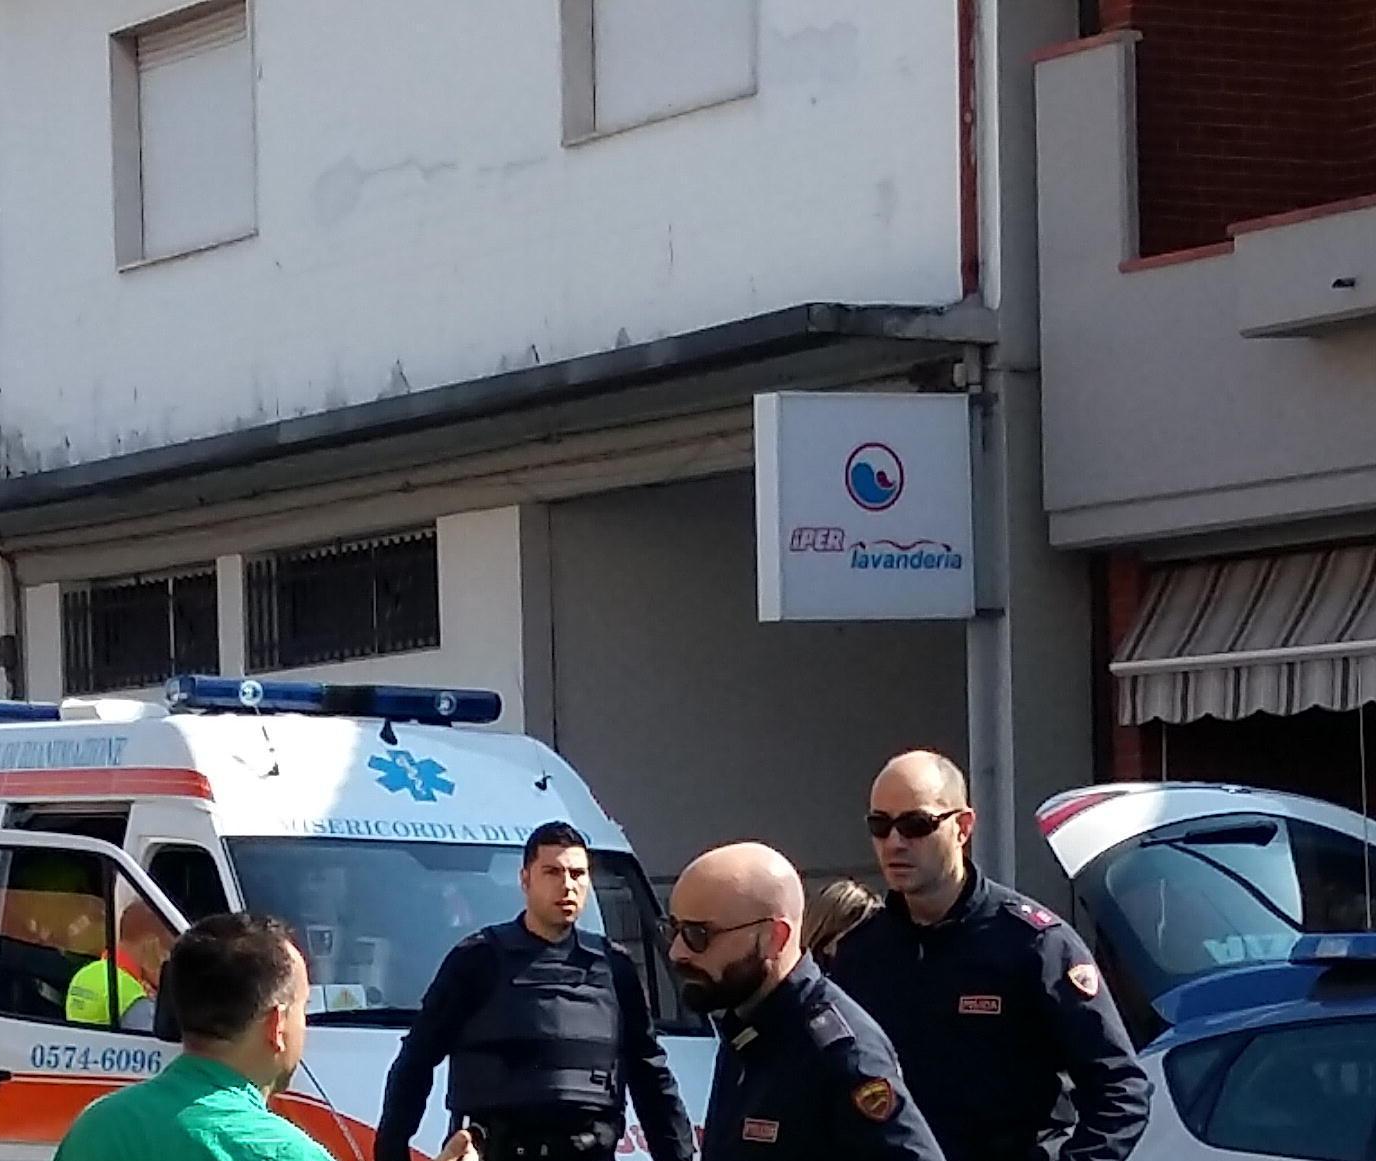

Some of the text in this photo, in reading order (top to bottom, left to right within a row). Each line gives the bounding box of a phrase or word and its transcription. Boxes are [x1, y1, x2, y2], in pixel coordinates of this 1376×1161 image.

[850, 551, 962, 570] lavanderia
[484, 823, 508, 842] DI
[31, 1044, 162, 1073] 0574-6096
